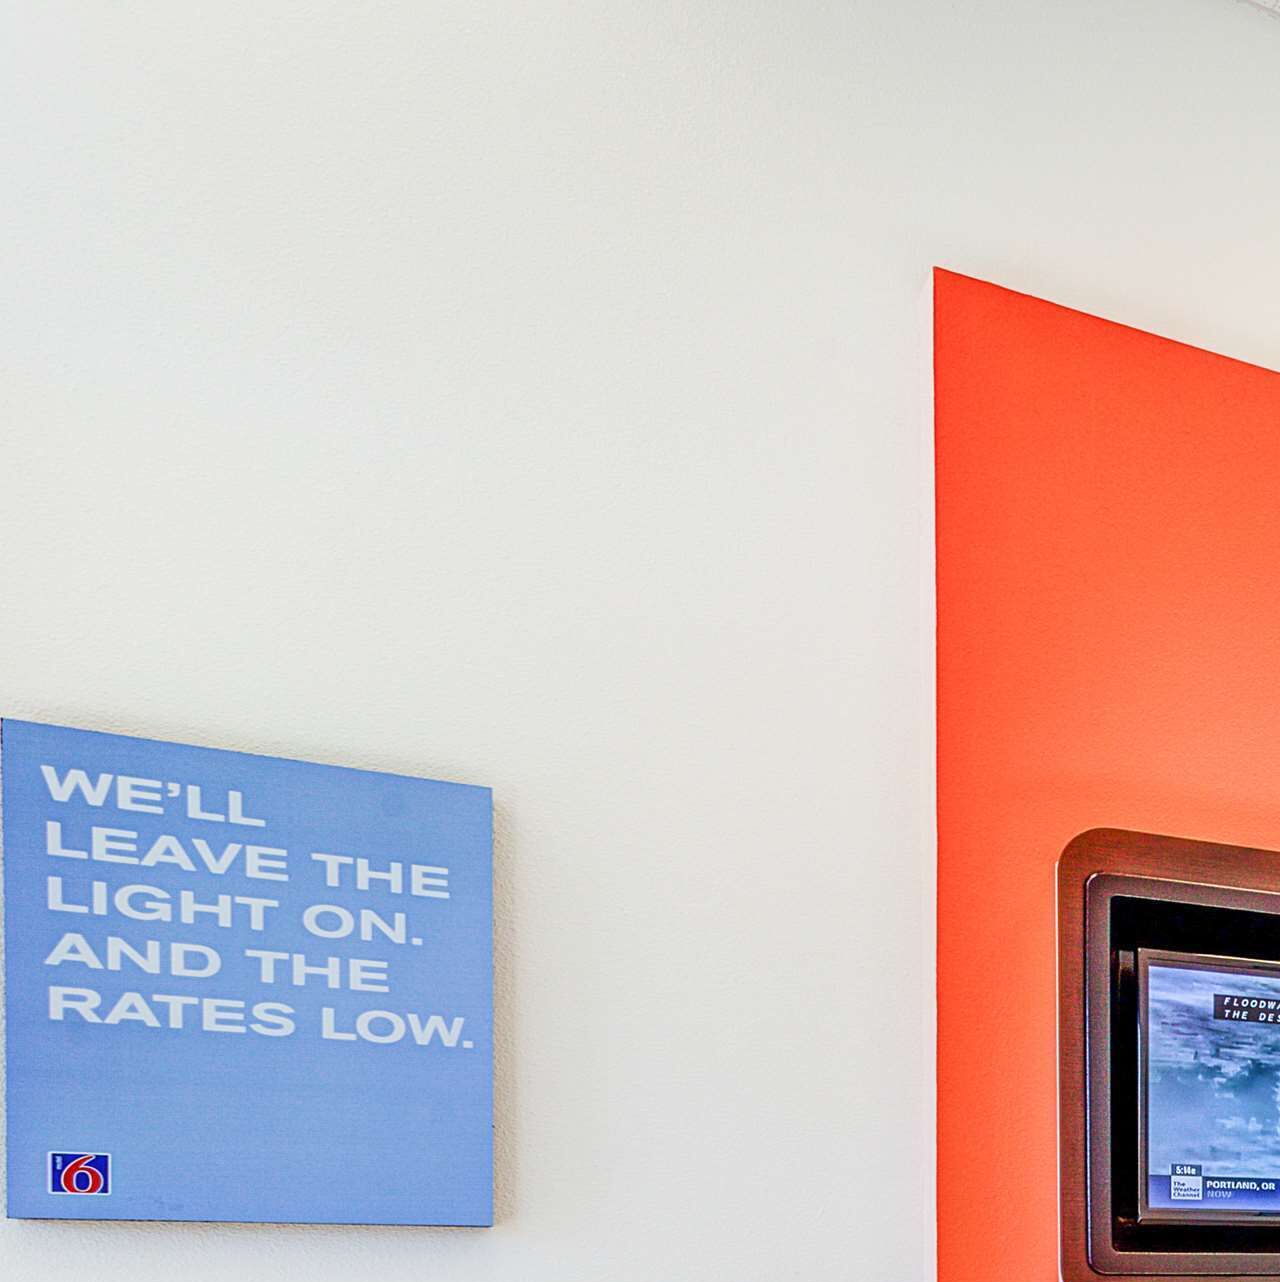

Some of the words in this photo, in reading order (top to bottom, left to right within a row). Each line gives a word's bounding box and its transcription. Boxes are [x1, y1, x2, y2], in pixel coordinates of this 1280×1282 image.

[39, 764, 266, 827] WE'LL
[45, 820, 290, 882] LEAVE
[311, 851, 451, 900] THE
[47, 875, 280, 932] LIGHT
[302, 903, 424, 946] ON.
[43, 931, 222, 979] AND
[245, 948, 390, 993] THE
[47, 985, 296, 1038] RATES
[322, 1006, 474, 1049] LOW.
[1223, 1009, 1249, 1020] THE
[61, 1154, 104, 1194] 6
[1206, 1180, 1260, 1192] PORTLAND,
[1261, 1183, 1276, 1191] OR
[1207, 1190, 1233, 1199] NOW
